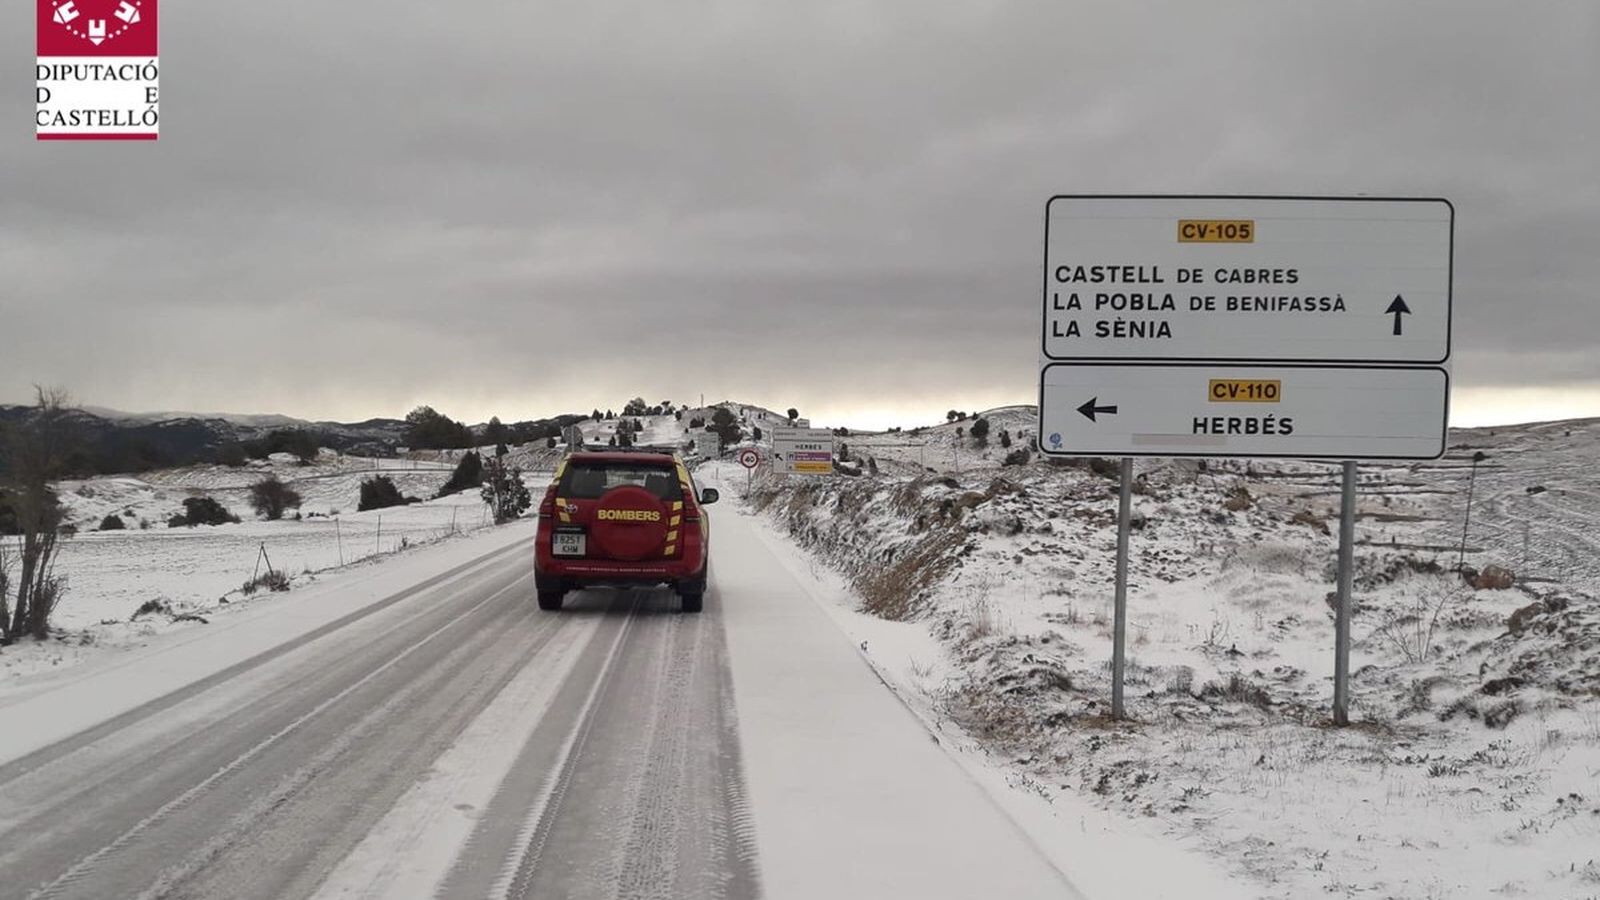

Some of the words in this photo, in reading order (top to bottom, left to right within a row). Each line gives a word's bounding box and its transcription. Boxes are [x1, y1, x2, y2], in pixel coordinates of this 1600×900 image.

[1182, 223, 1251, 239] CV-105
[1055, 265, 1164, 284] CASTELL
[1177, 268, 1204, 284] DE
[1214, 268, 1299, 284] CABRES
[1053, 293, 1082, 310] LA
[1095, 293, 1176, 311] POBLA
[1189, 296, 1216, 311] DE
[1226, 294, 1346, 312] BENIFASSÀ
[1053, 320, 1081, 337] LA
[1095, 316, 1172, 338] SÈNIA
[1212, 383, 1277, 399] CV-110
[1193, 414, 1293, 435] HERBÉS
[745, 455, 755, 463] 40
[597, 509, 661, 522] BOMBERS
